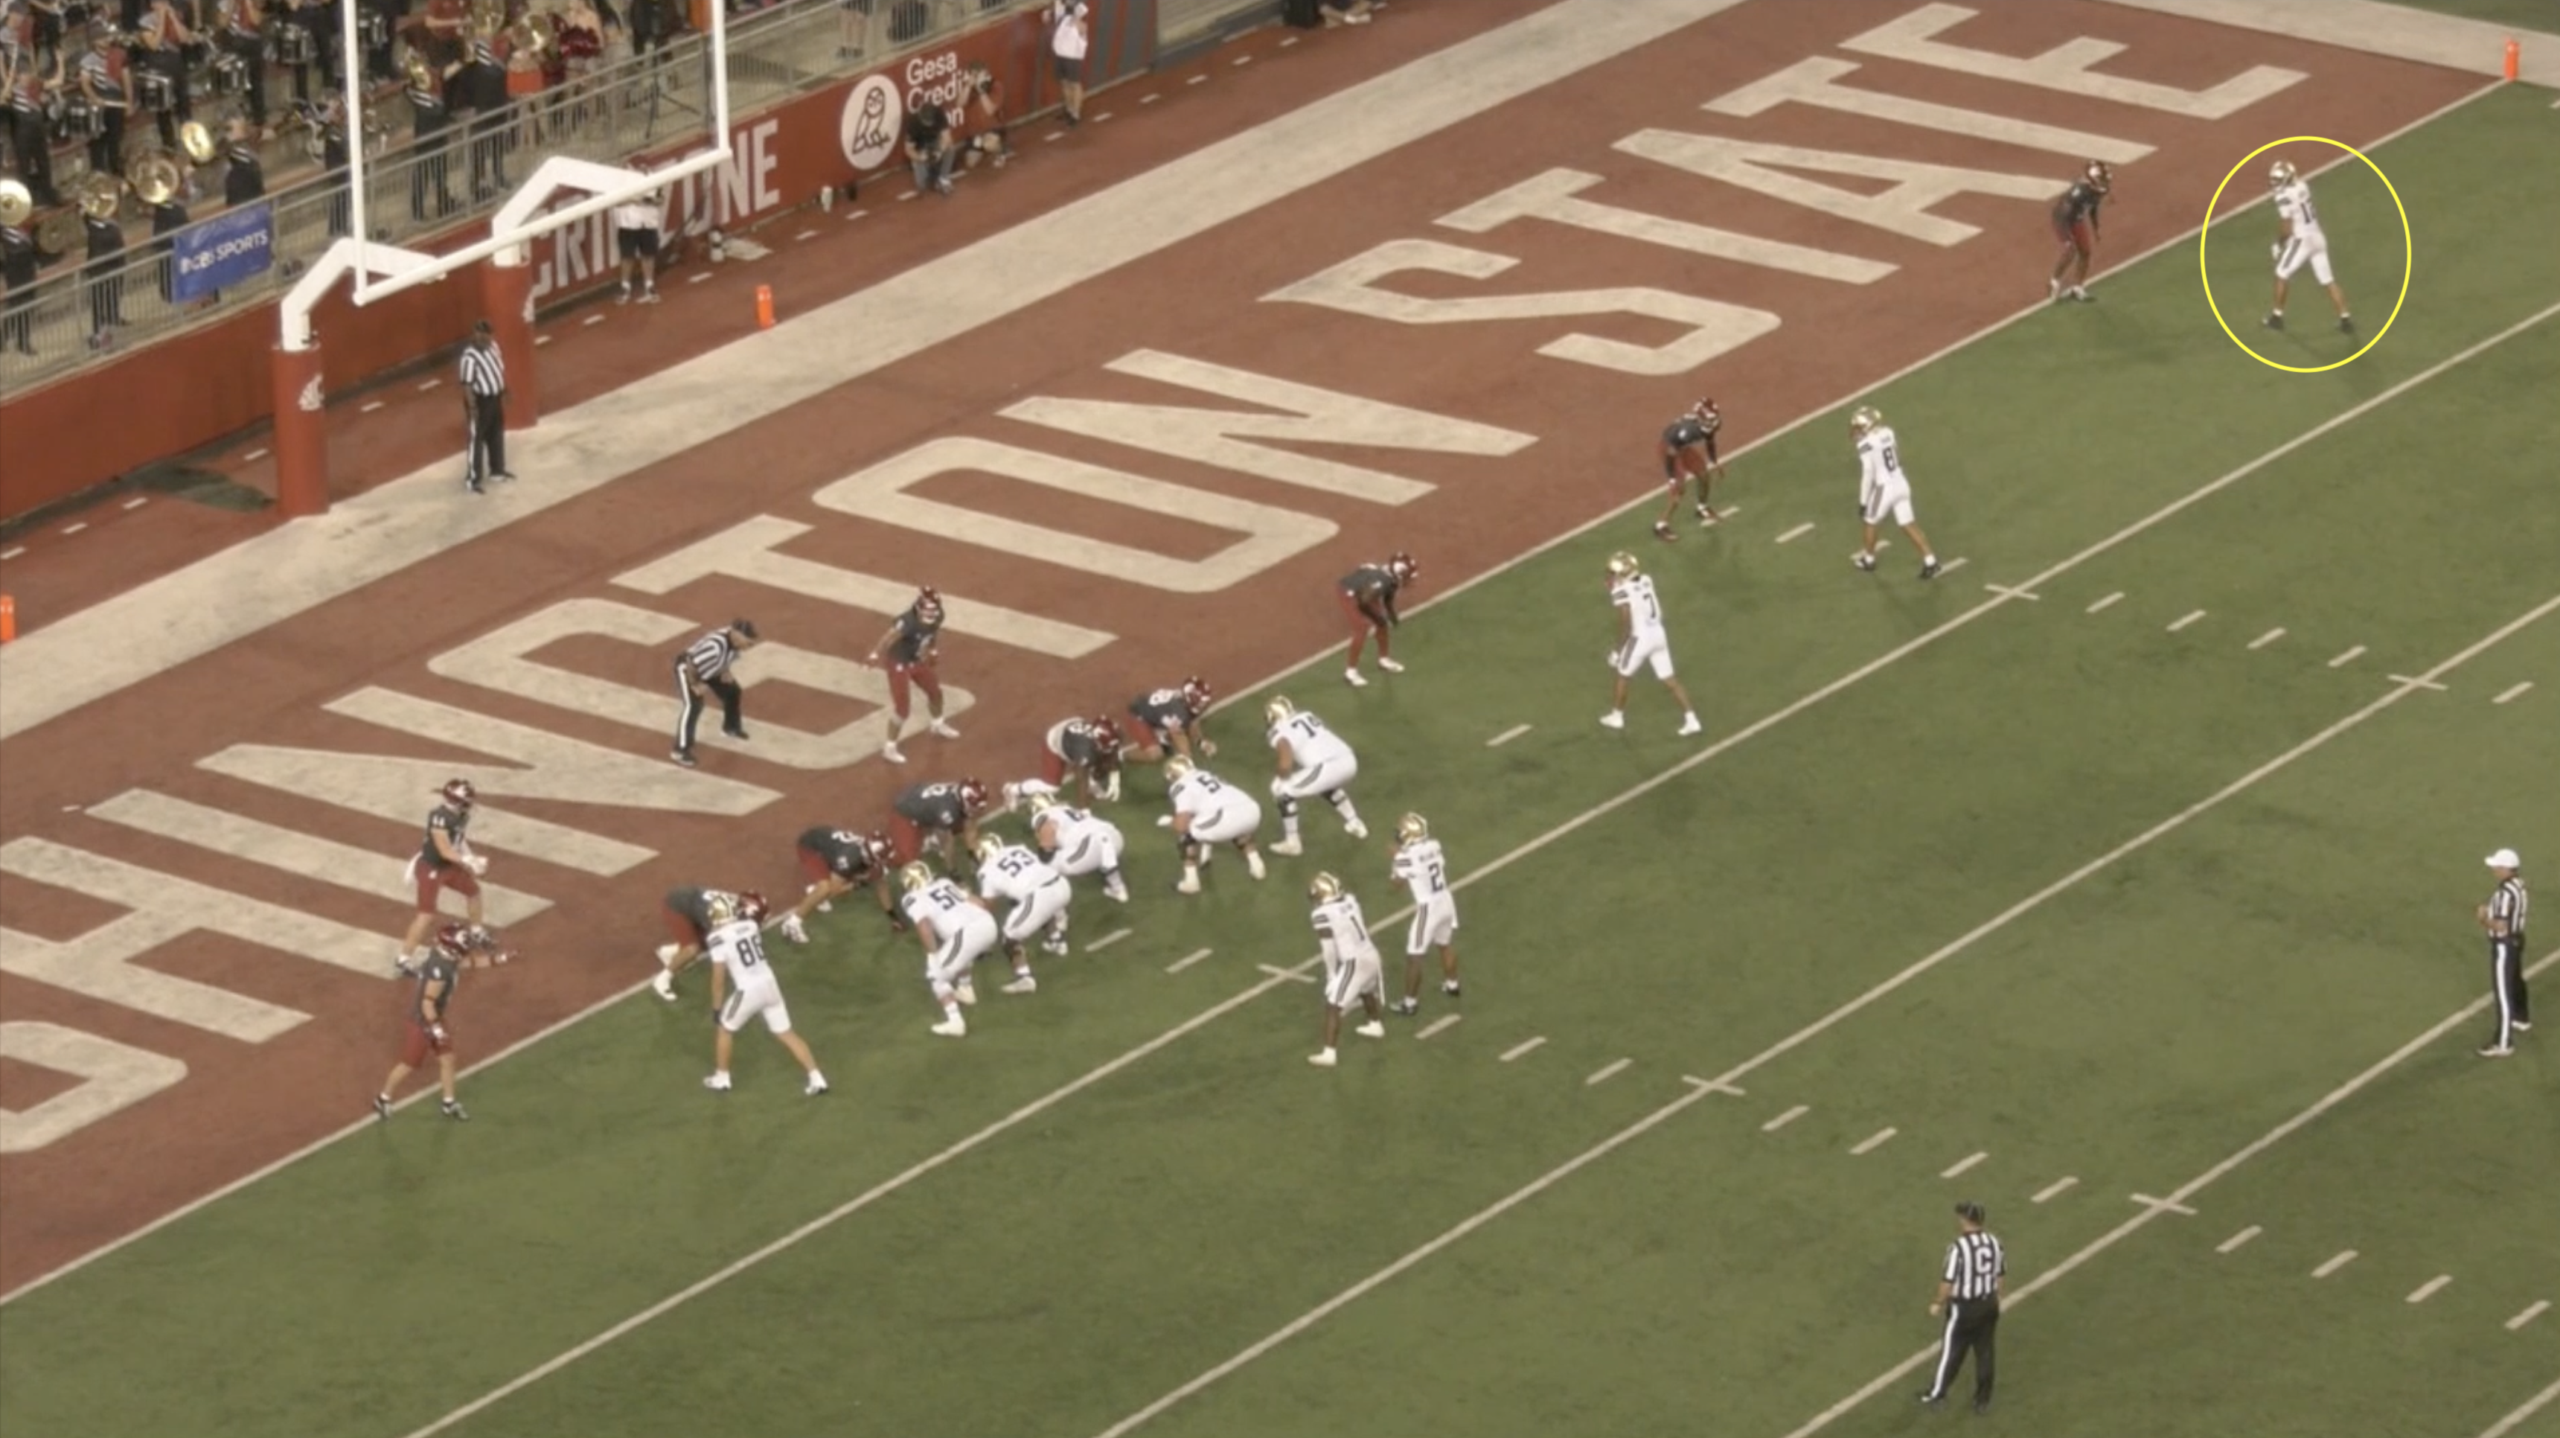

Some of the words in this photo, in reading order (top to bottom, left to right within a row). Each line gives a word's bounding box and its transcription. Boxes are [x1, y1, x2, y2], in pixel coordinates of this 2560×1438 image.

[906, 51, 957, 86] Gesa
[907, 72, 969, 114] Credi
[1258, 1, 2312, 375] STATE
[216, 229, 269, 261] SPORTS
[1643, 593, 1656, 618] 7
[998, 850, 1035, 877] 53
[1428, 862, 1444, 892] 2
[1350, 915, 1365, 941] 1
[1975, 1246, 1992, 1274] C
